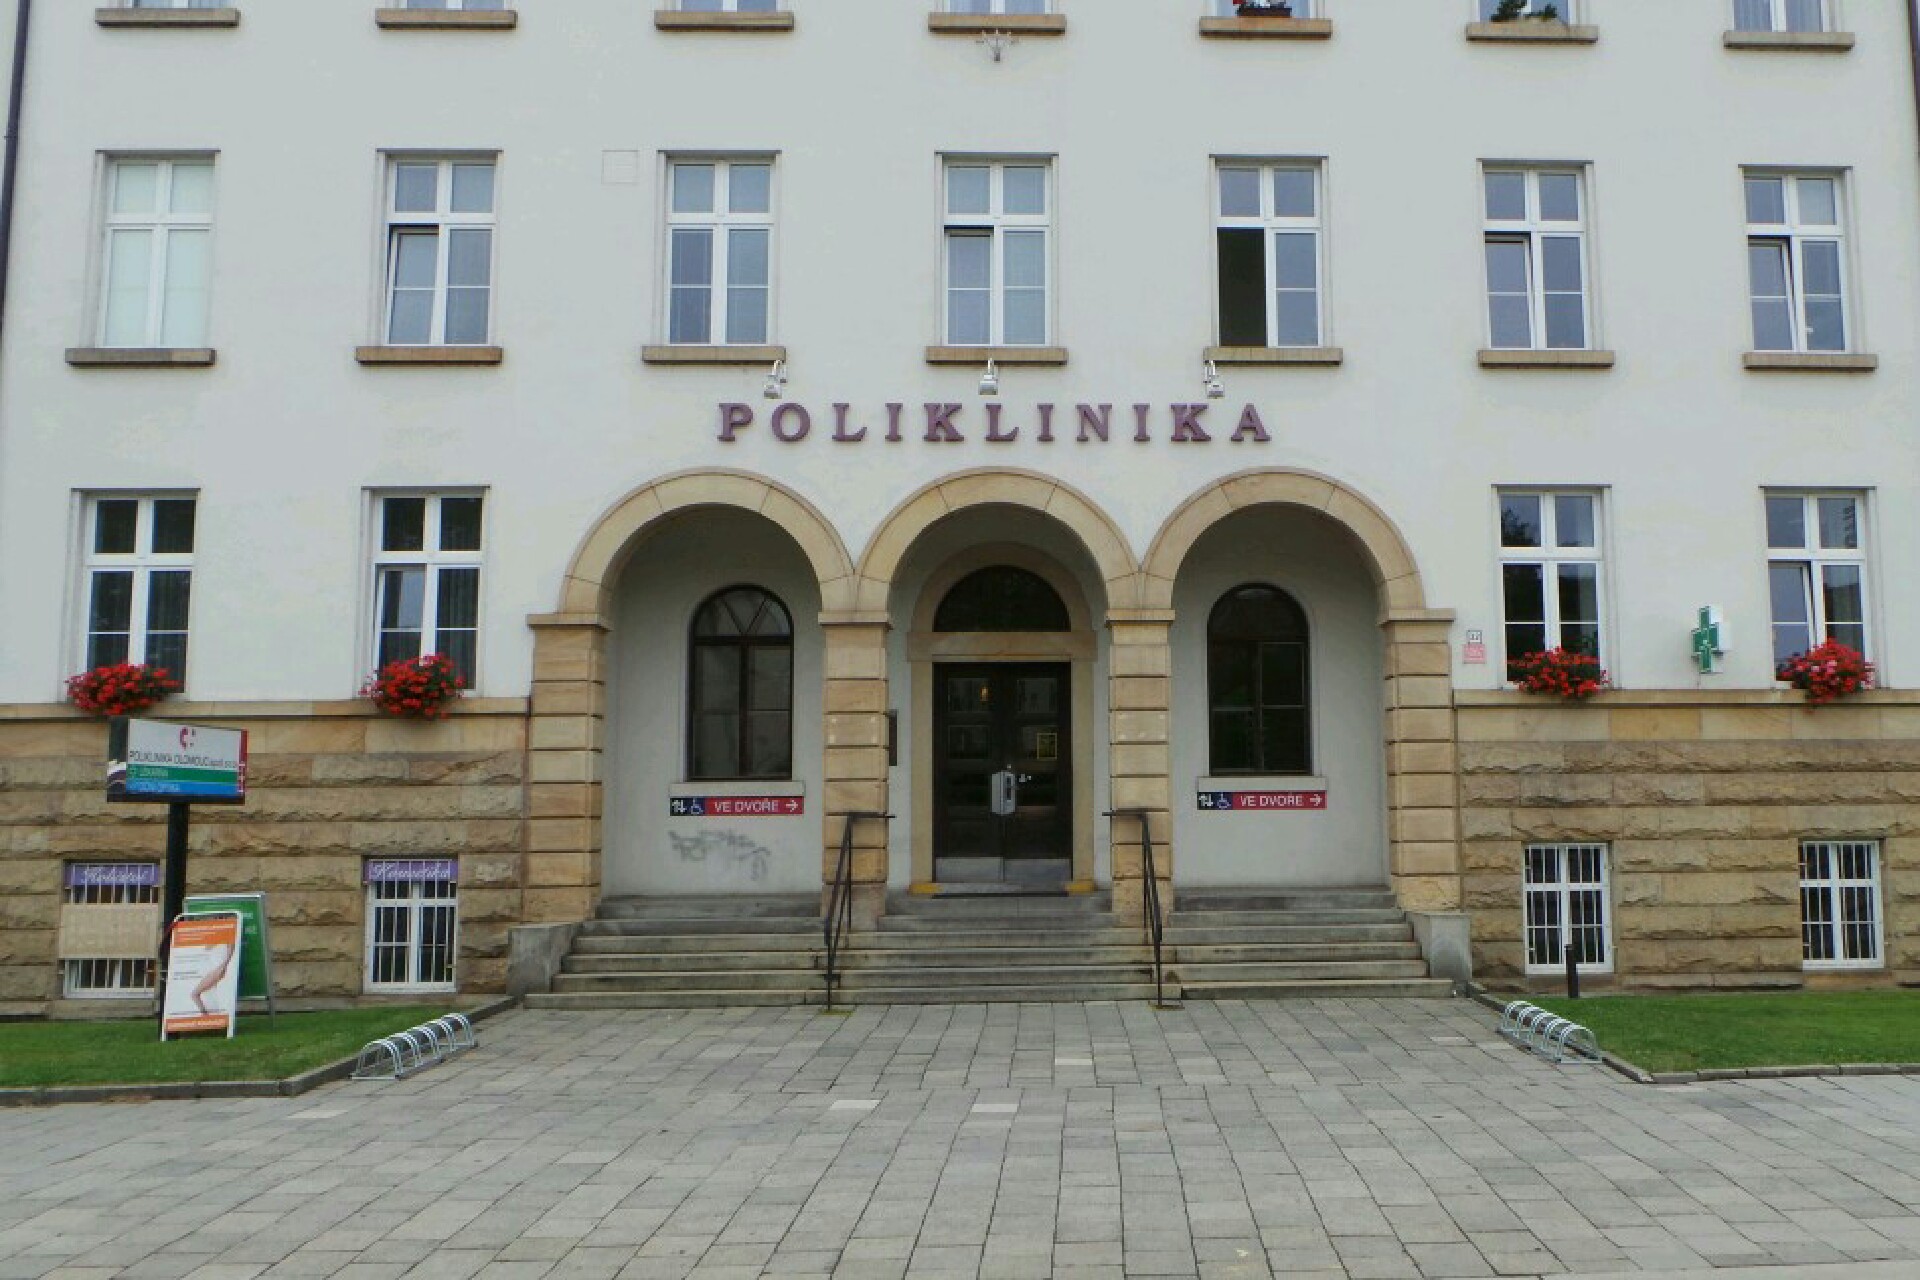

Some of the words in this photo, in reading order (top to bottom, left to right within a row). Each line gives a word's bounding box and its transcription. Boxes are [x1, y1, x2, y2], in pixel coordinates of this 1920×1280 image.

[717, 402, 1271, 443] POLIKLINIKA
[714, 801, 731, 813] VE
[1240, 795, 1257, 807] VE
